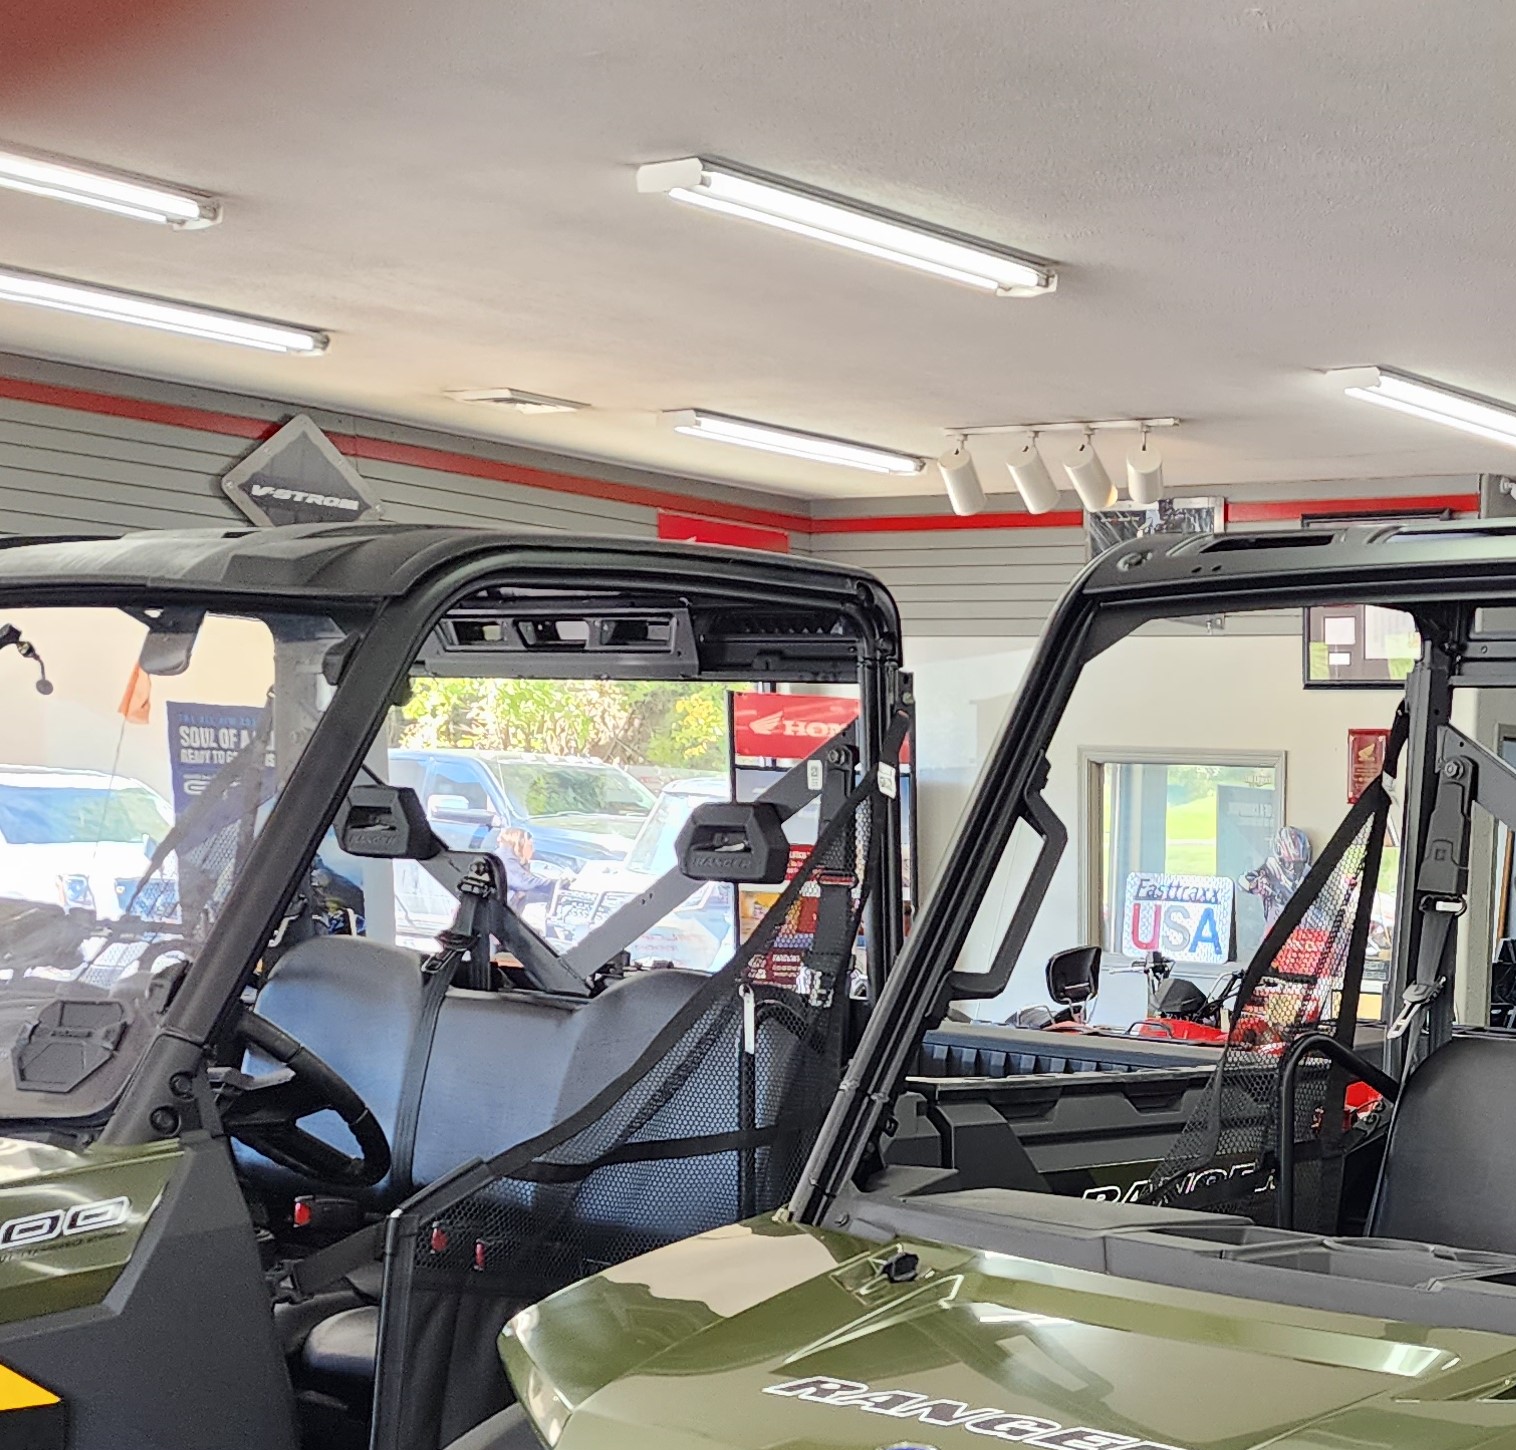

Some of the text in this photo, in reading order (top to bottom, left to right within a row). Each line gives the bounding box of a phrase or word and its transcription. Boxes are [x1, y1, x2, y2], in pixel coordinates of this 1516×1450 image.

[251, 484, 355, 511] V-STROM
[179, 725, 217, 747] SOUL
[219, 728, 238, 749] OF
[1134, 878, 1222, 905] Fasttraxx
[1132, 903, 1222, 955] USA
